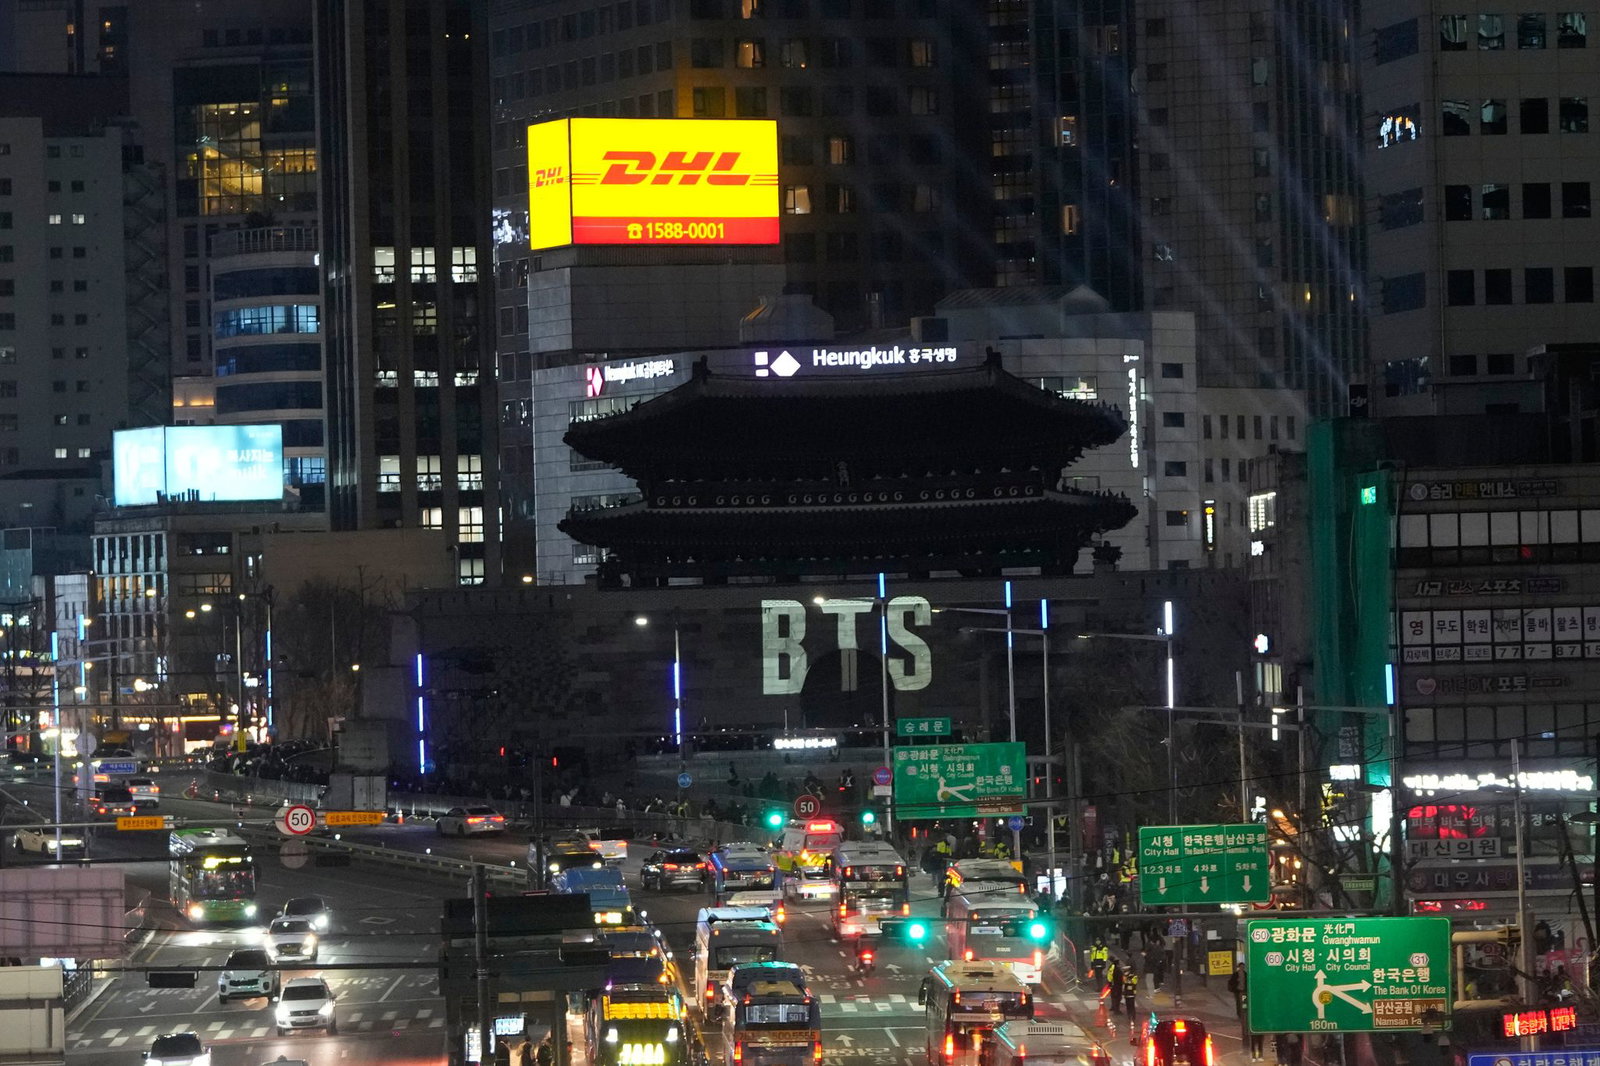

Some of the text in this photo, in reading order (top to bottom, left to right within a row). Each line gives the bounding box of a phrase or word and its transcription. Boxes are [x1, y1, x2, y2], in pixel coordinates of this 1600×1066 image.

[600, 151, 751, 185] DHL
[536, 167, 564, 187] DHL
[646, 222, 724, 239] 1588-0001
[813, 346, 957, 369] Heungkuk 흥국생명
[1429, 483, 1452, 499] 승리
[1479, 482, 1516, 498] 안내소
[1478, 579, 1521, 595] 스포츠
[1409, 620, 1423, 636] 영
[1436, 620, 1458, 634] 무도
[1466, 619, 1489, 634] 학원
[1557, 617, 1579, 632] 왈츠
[1587, 617, 1600, 632] 탱
[761, 596, 932, 694] BTS
[1498, 676, 1528, 692] 포토
[909, 750, 939, 760] 광화문
[946, 763, 975, 773] 시의회
[975, 775, 1013, 786] 한국은행
[800, 803, 814, 812] 50
[292, 813, 309, 826] 50
[1411, 818, 1435, 829] 피부
[1151, 835, 1173, 847] 시청
[1184, 834, 1225, 846] 한국은행
[1225, 833, 1266, 845] 남산공원
[1144, 847, 1179, 857] City Hall
[1411, 839, 1496, 857] 대신의원
[1323, 923, 1355, 934] 光化門
[1254, 927, 1317, 943] 50 광화문
[1322, 935, 1380, 947] Gwanghwamun
[1268, 947, 1371, 964] 60 시청 시의회
[1414, 955, 1425, 964] 31
[1285, 963, 1316, 972] City Hall
[1326, 962, 1371, 972] City Council
[1372, 967, 1430, 983] 한국은행
[1373, 985, 1446, 995] The Bank Of Korea
[1375, 1001, 1413, 1014] 남산공원
[1309, 1020, 1338, 1030] 180m
[1375, 1017, 1409, 1026] Namsan
[1519, 1017, 1548, 1035] 승합차
